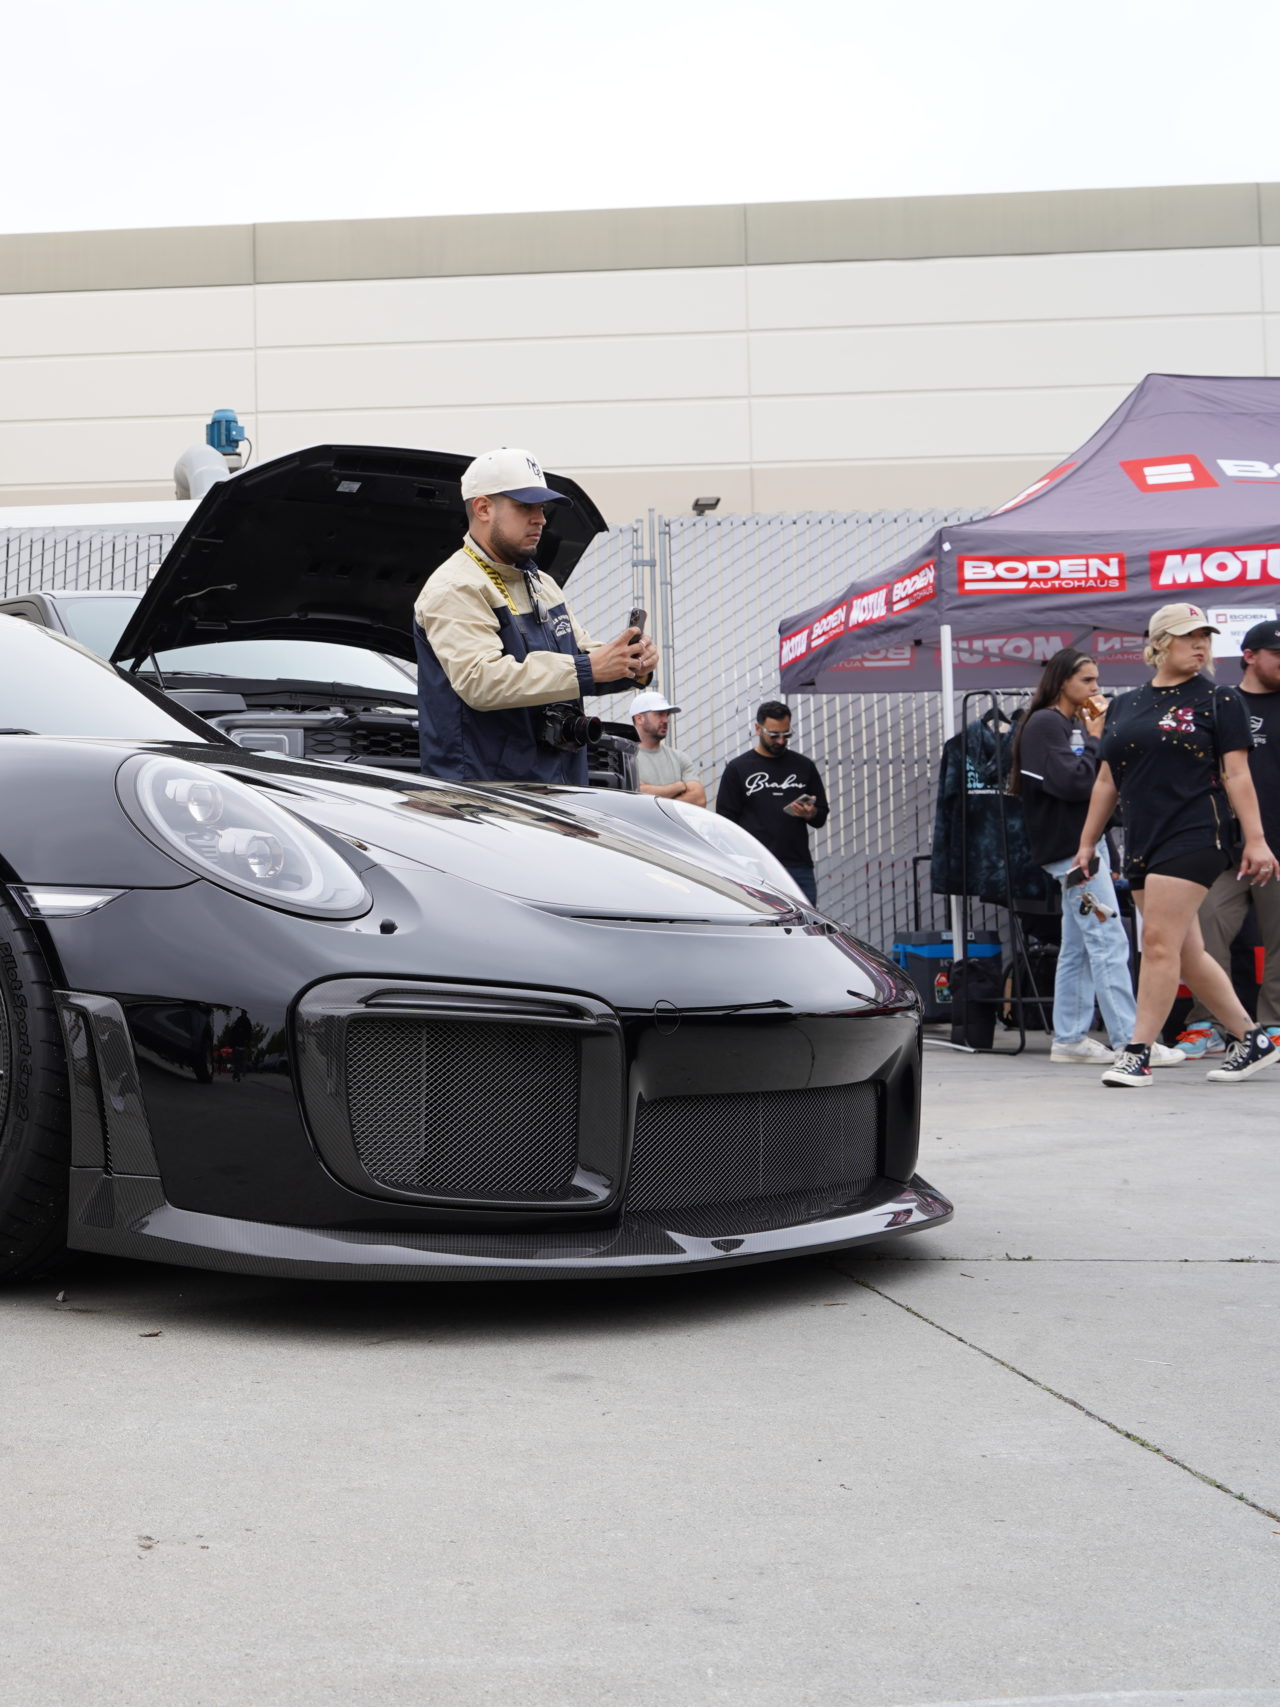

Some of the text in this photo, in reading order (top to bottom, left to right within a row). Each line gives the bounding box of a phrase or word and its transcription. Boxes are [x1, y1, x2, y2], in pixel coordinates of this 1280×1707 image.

[892, 564, 935, 602] BODEN
[964, 558, 1119, 580] BODEN
[1029, 579, 1119, 589] AUTOHAUS
[848, 588, 887, 627] MOTUL
[13, 993, 32, 1056] Sport
[16, 1058, 33, 1099] Cup
[16, 1103, 29, 1121] 2
